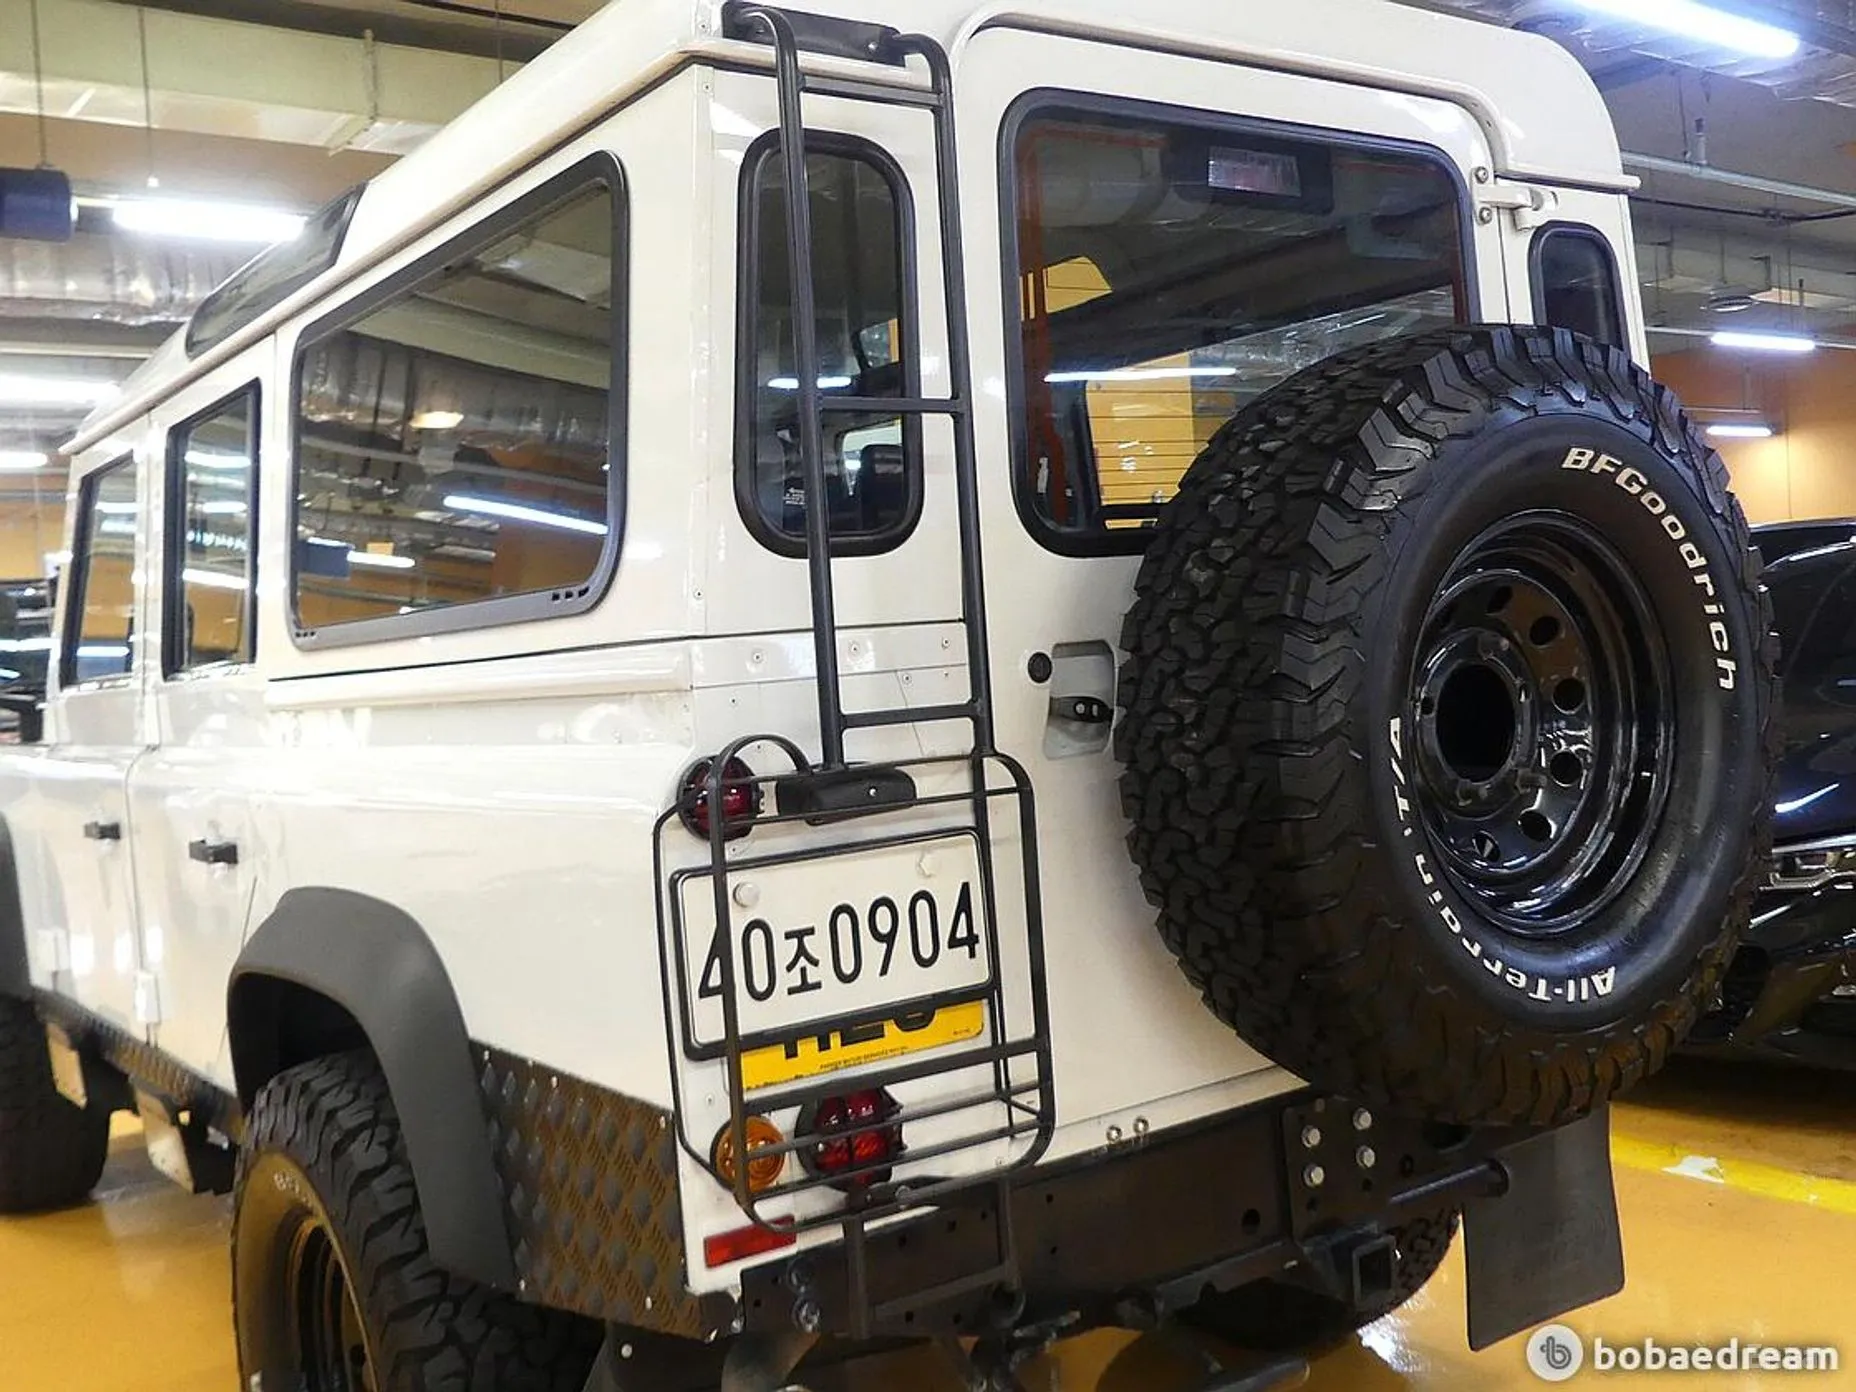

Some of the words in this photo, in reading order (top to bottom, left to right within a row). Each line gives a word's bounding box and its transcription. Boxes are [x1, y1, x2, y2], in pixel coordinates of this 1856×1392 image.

[1562, 447, 1737, 690] BFGoodrich
[698, 881, 980, 1002] 40조0904
[1414, 853, 1616, 1003] All-Terrain
